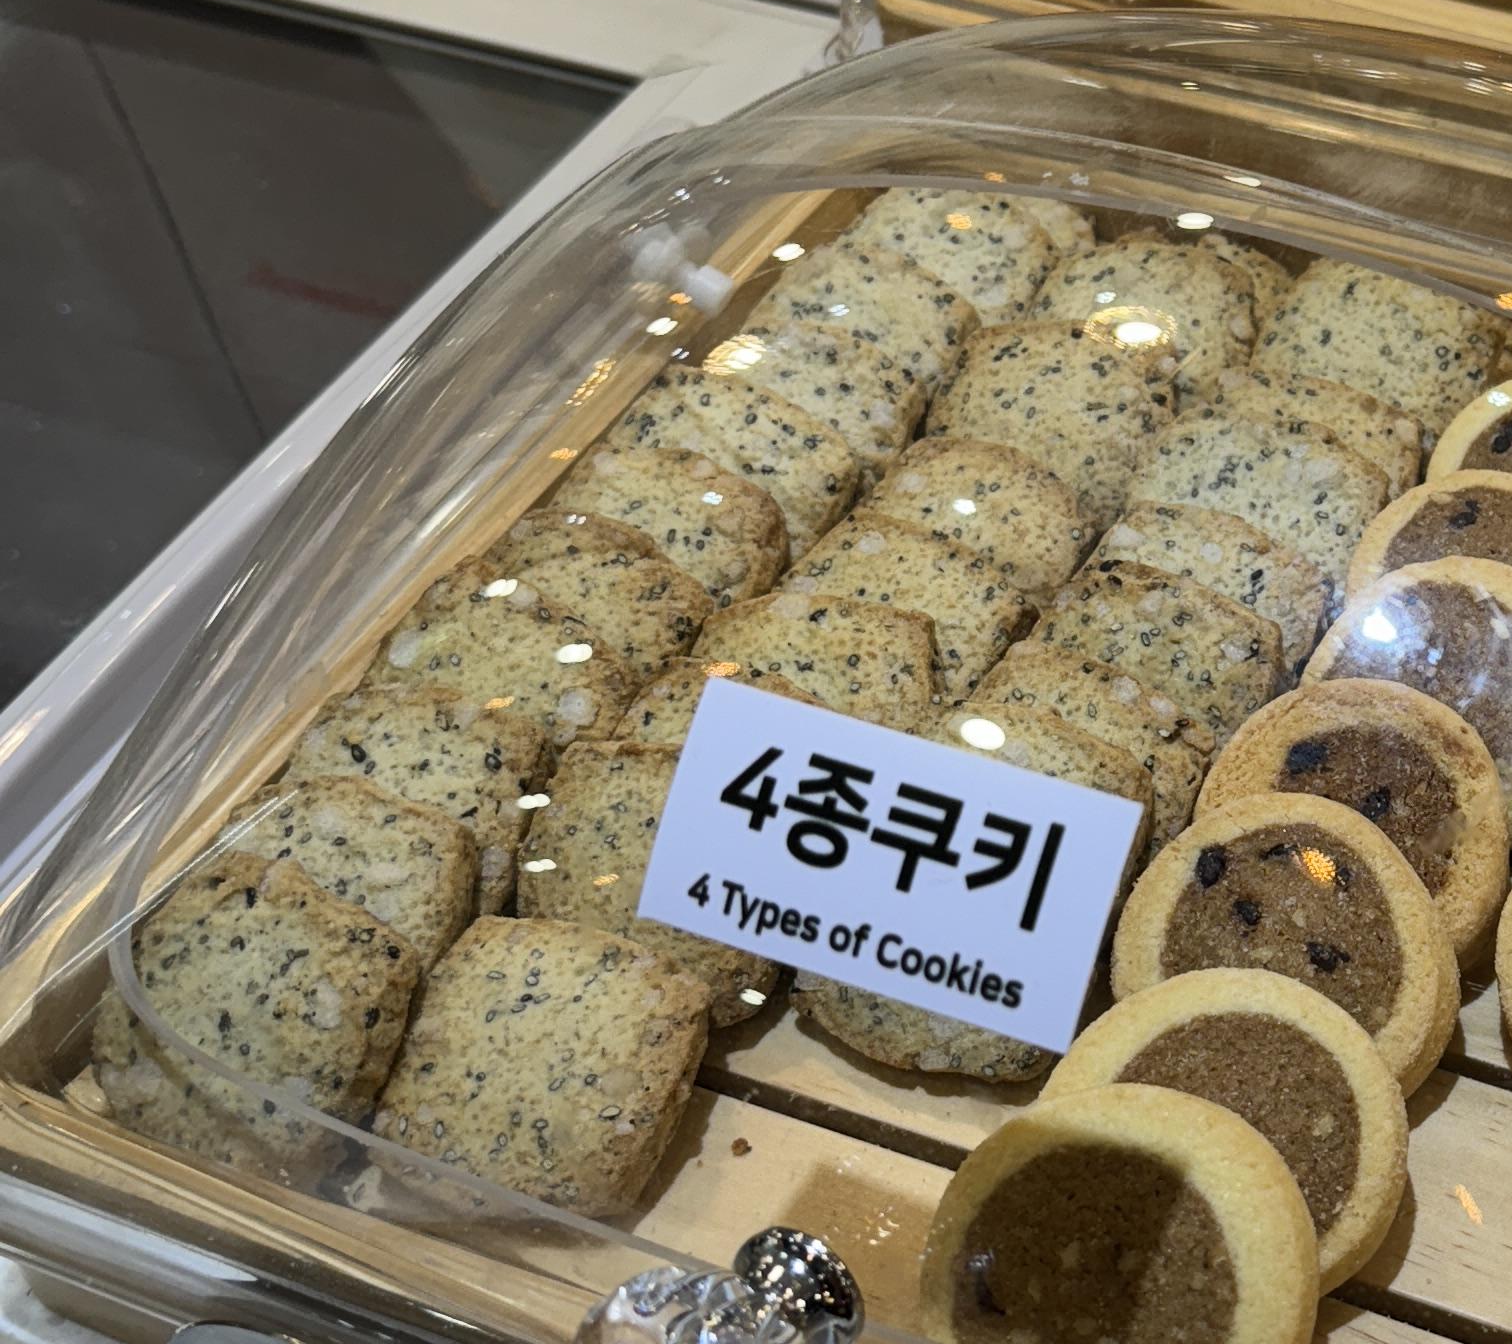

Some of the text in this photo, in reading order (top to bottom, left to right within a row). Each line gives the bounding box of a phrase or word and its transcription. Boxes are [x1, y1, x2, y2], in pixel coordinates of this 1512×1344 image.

[720, 746, 1066, 932] 4종쿠키
[687, 873, 1024, 1009] 4 Types of Cookies
